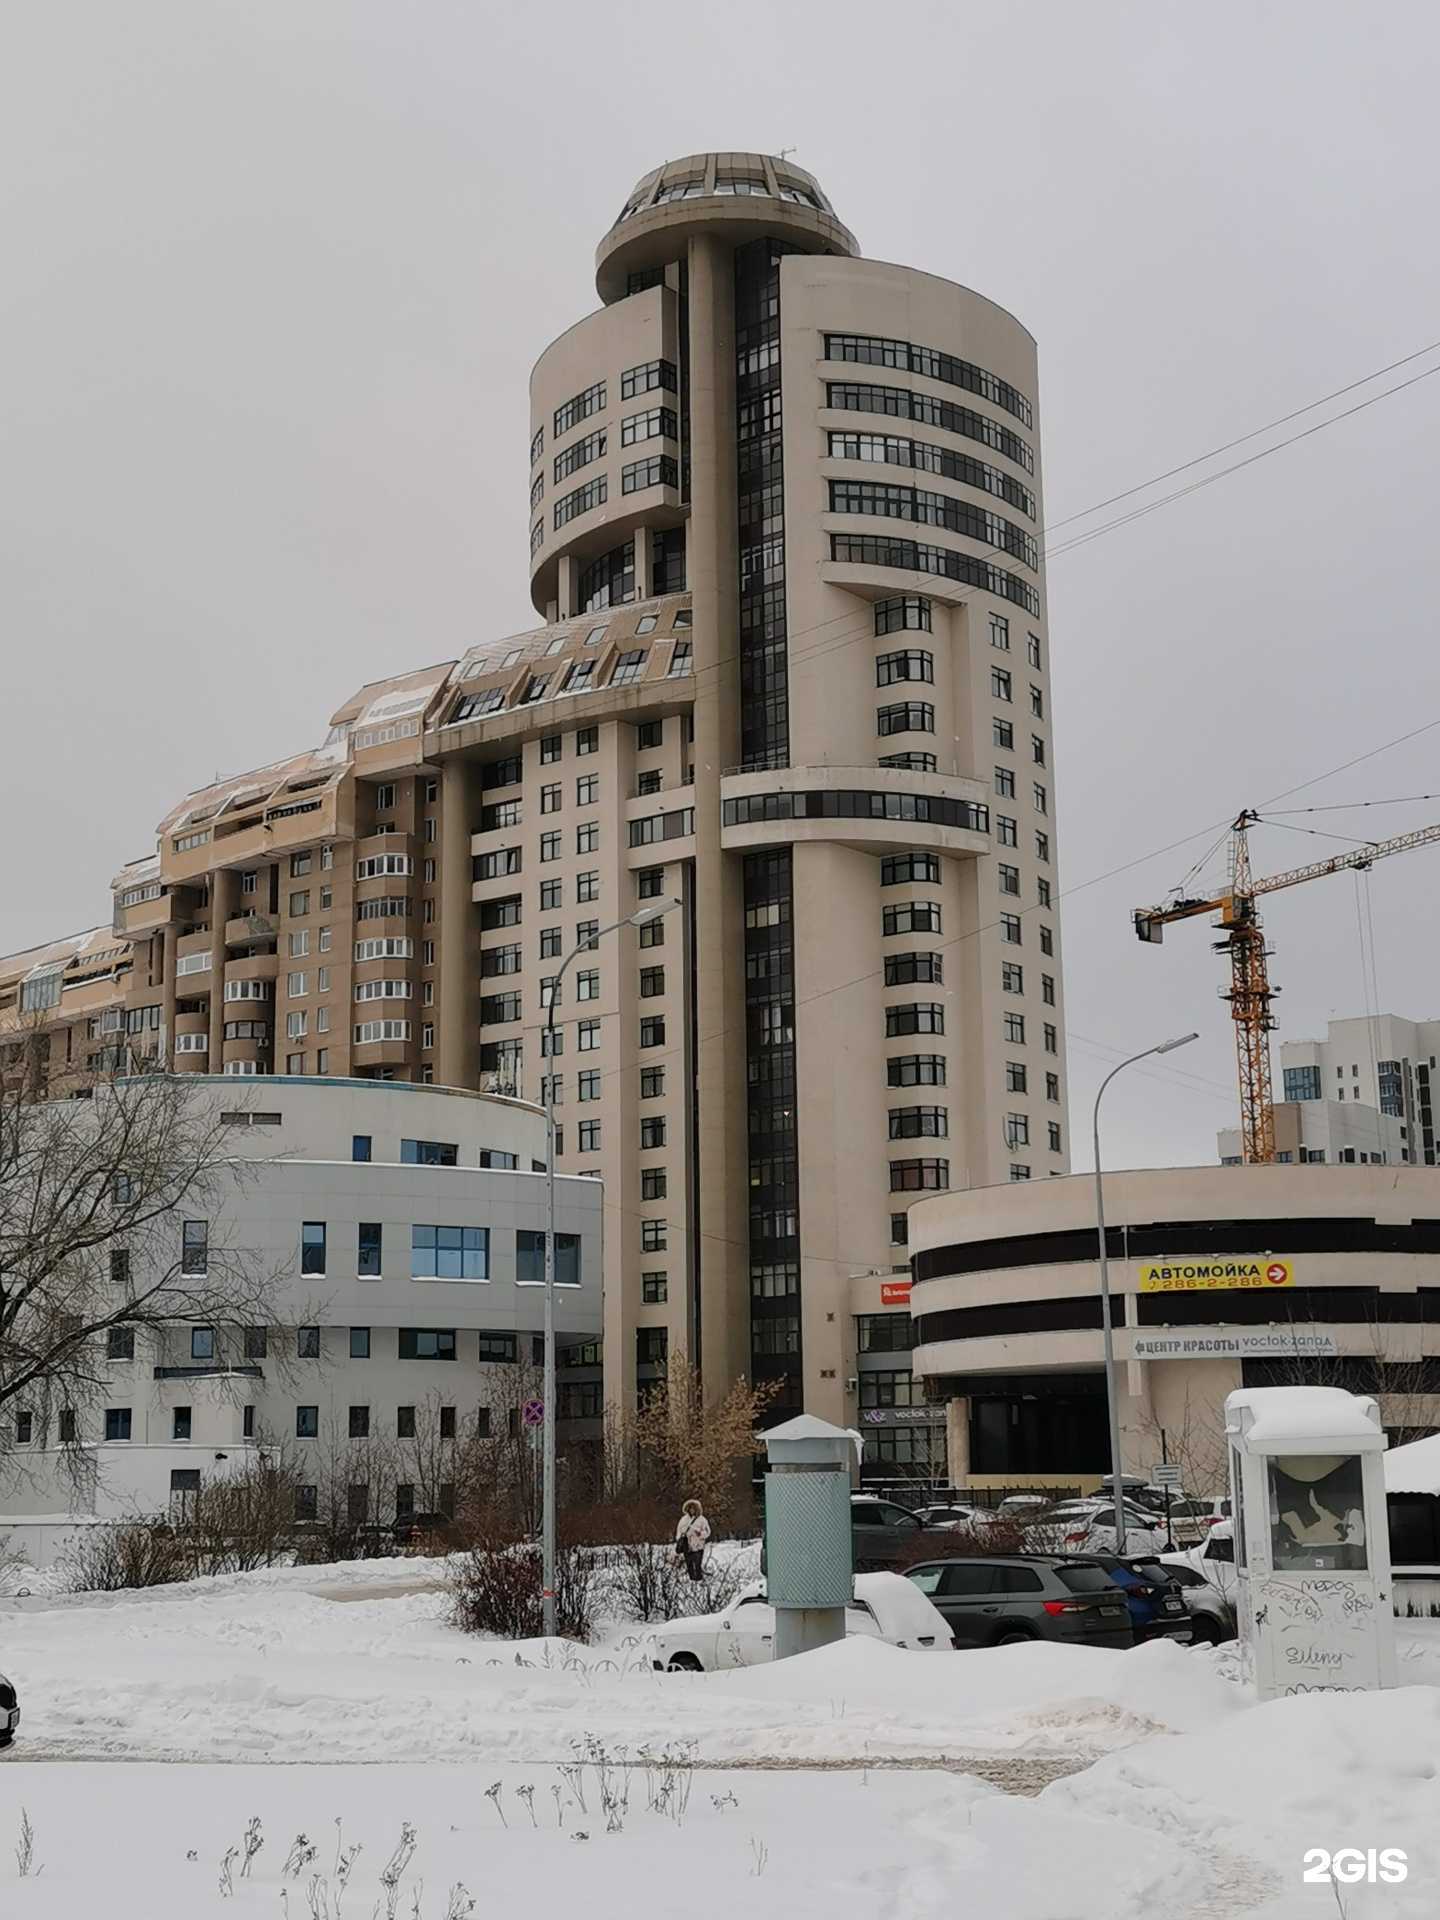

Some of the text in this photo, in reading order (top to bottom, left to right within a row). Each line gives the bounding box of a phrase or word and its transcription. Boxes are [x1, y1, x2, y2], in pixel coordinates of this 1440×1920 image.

[1149, 1263, 1261, 1280] АВТОМОЙКА
[1163, 1277, 1263, 1289] 286-2-286
[1146, 1340, 1181, 1354] ЦЕНТР
[1183, 1338, 1240, 1352] КРАСОТЫ
